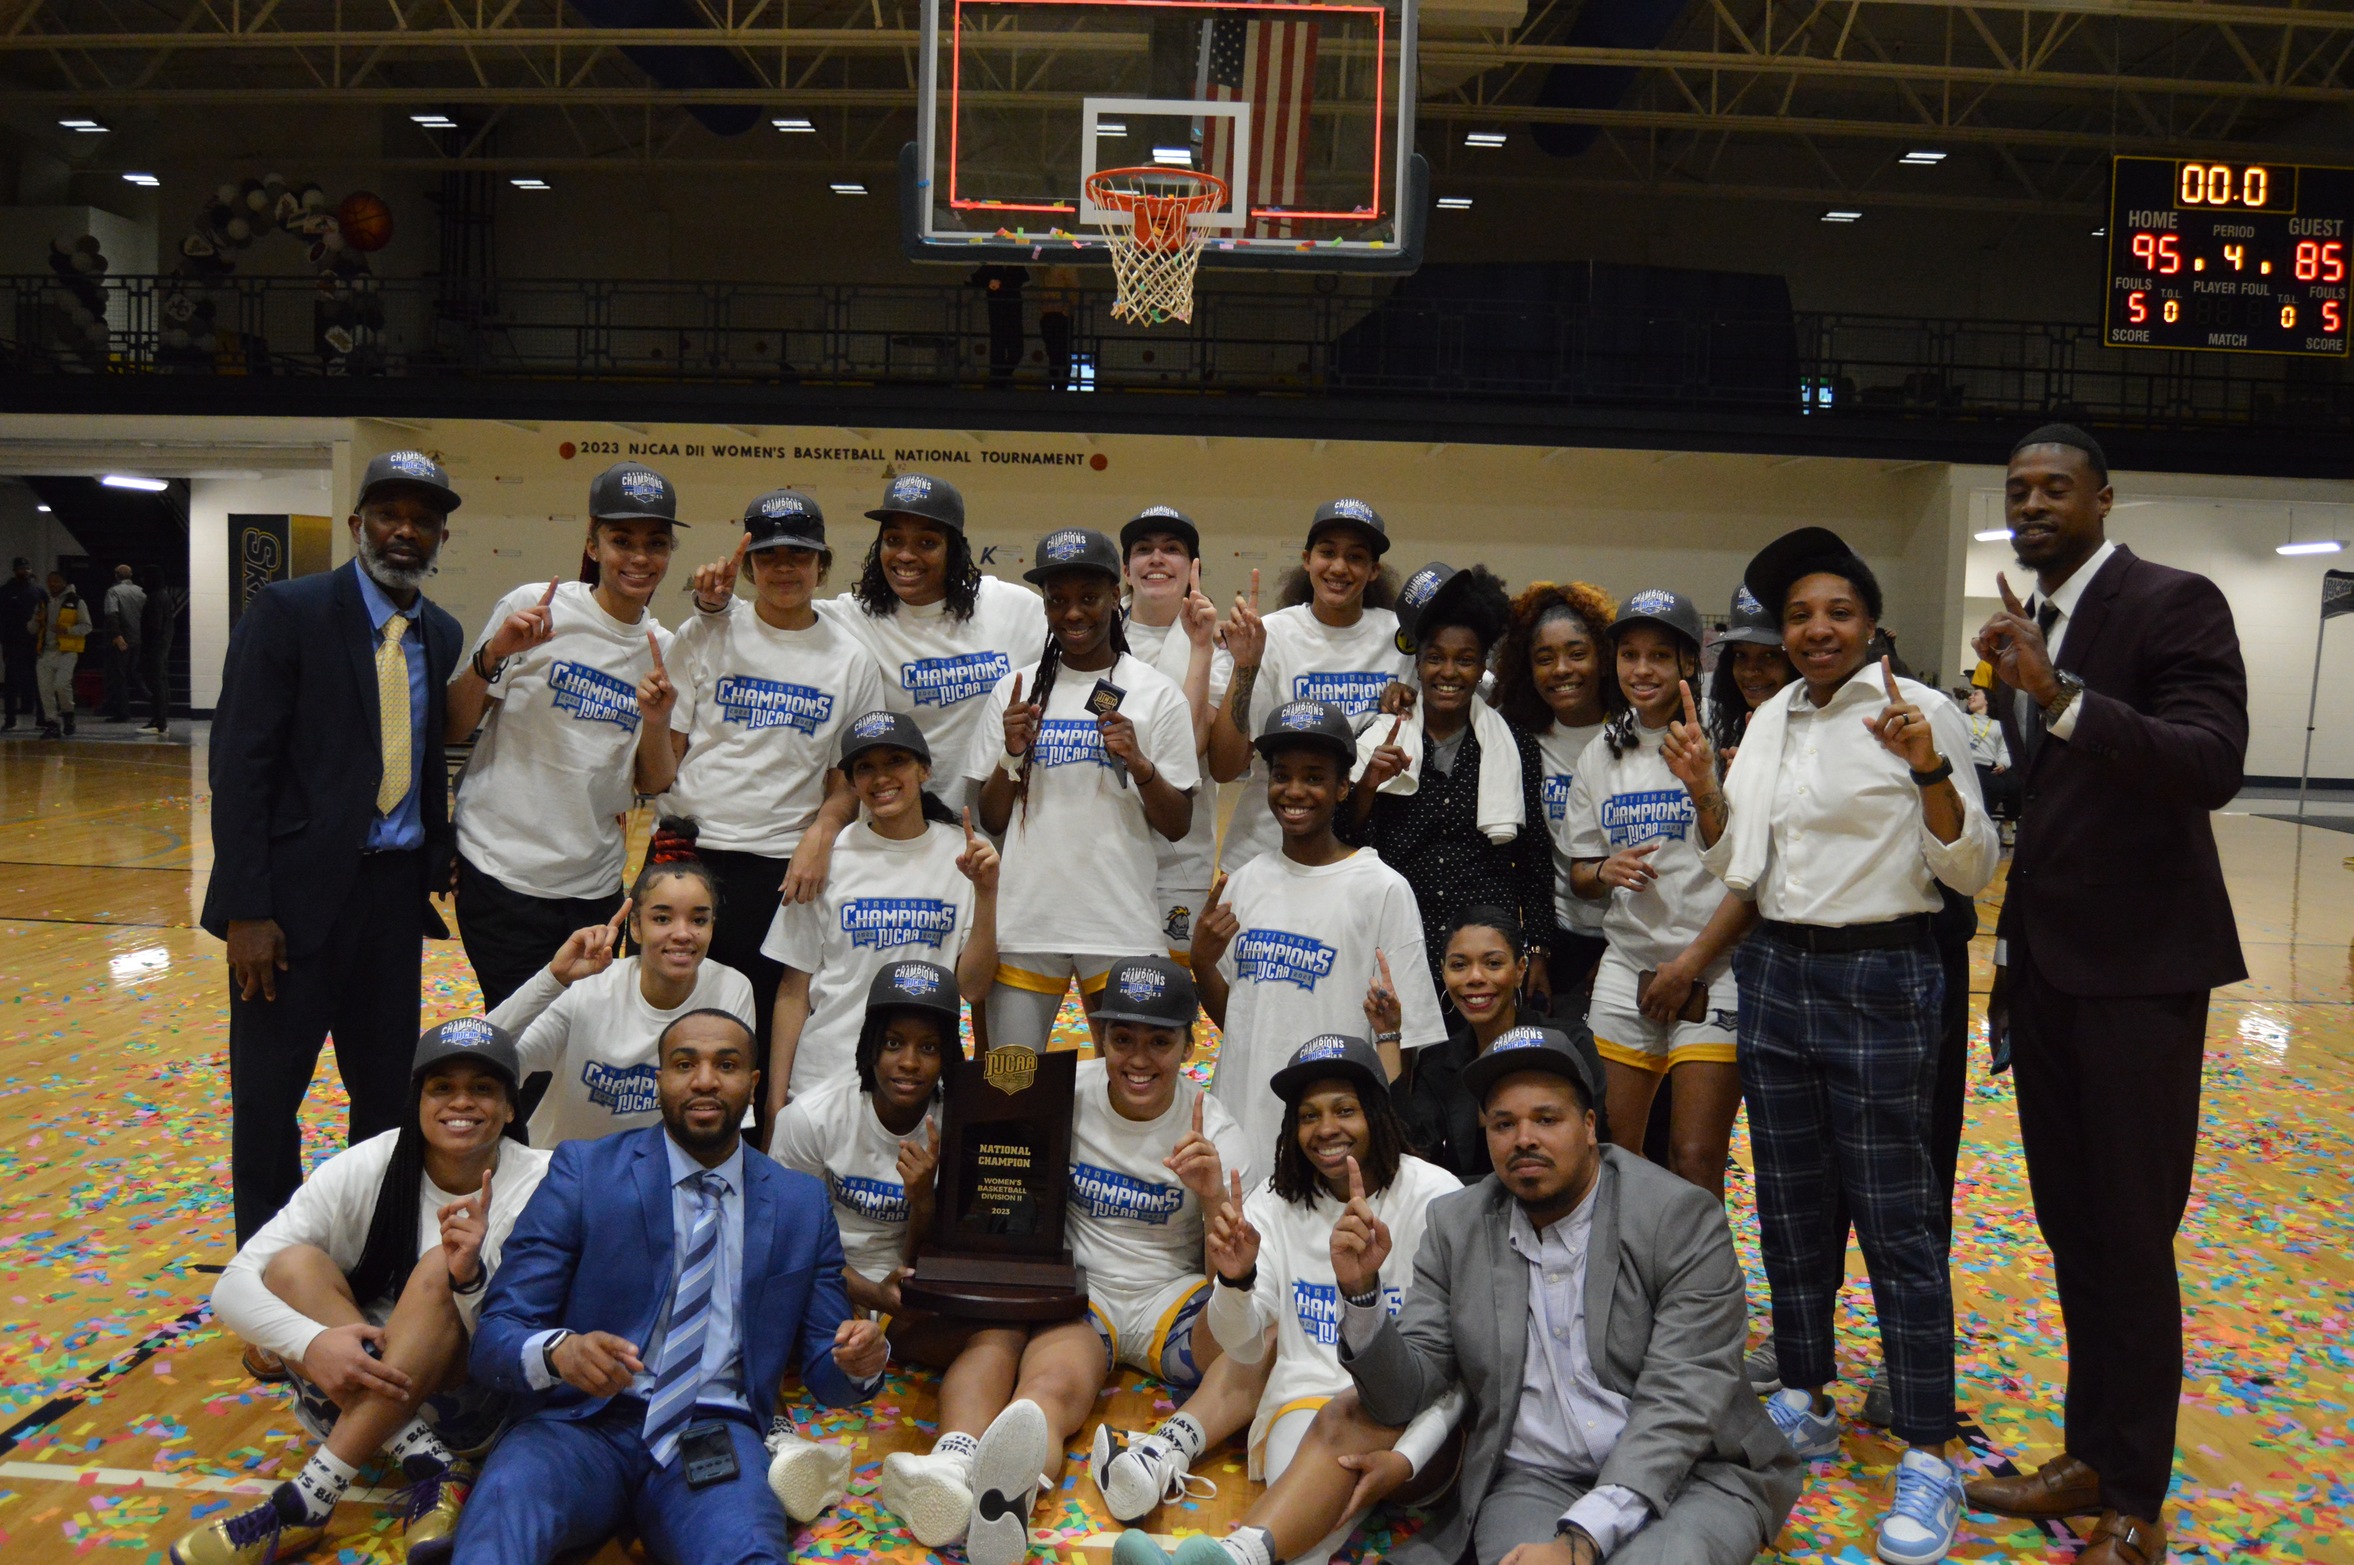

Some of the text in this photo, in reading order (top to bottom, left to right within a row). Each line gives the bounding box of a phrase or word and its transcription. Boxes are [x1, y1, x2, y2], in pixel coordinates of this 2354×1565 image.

[2181, 164, 2268, 206] 00.0
[2128, 210, 2178, 229] HOME
[2288, 217, 2344, 237] GUEST
[2213, 224, 2255, 238] PERIOD
[2132, 234, 2181, 273] 95
[2223, 245, 2243, 270] 4
[2295, 242, 2344, 281] 85
[2115, 277, 2152, 290] FOULS
[2193, 280, 2270, 296] PLAYER FOUL
[2309, 285, 2346, 299] FOULS
[2128, 292, 2146, 323] 5
[2163, 300, 2179, 323] 0
[2321, 301, 2340, 331] 5
[2280, 306, 2296, 328] 0
[2112, 329, 2150, 342] SCORE
[2208, 333, 2247, 347] MATCH
[2306, 337, 2343, 351] SCORE
[581, 442, 619, 454] 2023
[629, 443, 679, 456] NJCAA
[712, 445, 785, 459] WOMEN'S
[794, 447, 885, 461] BASKETBALL
[895, 449, 971, 463] NATIONAL
[981, 452, 1084, 465] TOURNAMENT
[622, 475, 663, 489] CHAMPIONS
[762, 499, 803, 513] CHAMPIONS
[1046, 534, 1086, 549] CHAMPIONS
[922, 655, 989, 669] NATIONAL
[903, 655, 1008, 688] CHAMPIONS
[1315, 674, 1380, 683] NATIONAL
[550, 662, 641, 716] CHAMPION
[576, 666, 635, 696] NATIONAL
[741, 680, 812, 696] NATIONAL
[718, 680, 830, 720] CHAMPIONS
[939, 682, 981, 705] NJCAA
[577, 699, 618, 720] NJCAA
[750, 708, 793, 727] NJCAA
[1281, 703, 1324, 718] CHAMPIONS
[854, 714, 895, 731] CHAMPIONS
[1048, 746, 1088, 765] NJCAA
[1615, 793, 1675, 805] NATIONAL
[1604, 797, 1696, 826] CHAMPIONS
[1627, 823, 1658, 845] NJCAA
[862, 901, 936, 909] NATIONAL
[843, 904, 954, 930] CHAMPIONS
[877, 928, 919, 949] NJCAA
[1250, 932, 1312, 949] NATIONAL
[1236, 936, 1333, 972] CHAMPIONS
[894, 967, 939, 983] CHAMPIONS
[1120, 970, 1166, 986] CHAMPIONS
[441, 1020, 493, 1036] CHAMPIONS
[1300, 1039, 1345, 1058] CHAMPIONS
[1493, 1029, 1543, 1051] CHAMPIONS
[609, 1068, 650, 1078] NATIO
[985, 1053, 1037, 1079] NJCAA
[980, 1144, 1031, 1155] NATIONAL
[978, 1156, 1031, 1168] CHAMPION
[850, 1180, 904, 1195] NATION
[978, 1185, 1027, 1194] BASKETBALL
[984, 1177, 1022, 1186] WOMEN'S
[1069, 1167, 1180, 1211] HAMPIONS
[1083, 1167, 1159, 1194] NATIONAL
[981, 1193, 1016, 1201] DIVISION
[992, 1207, 1010, 1215] 2023
[1092, 1200, 1138, 1218] NJCAA
